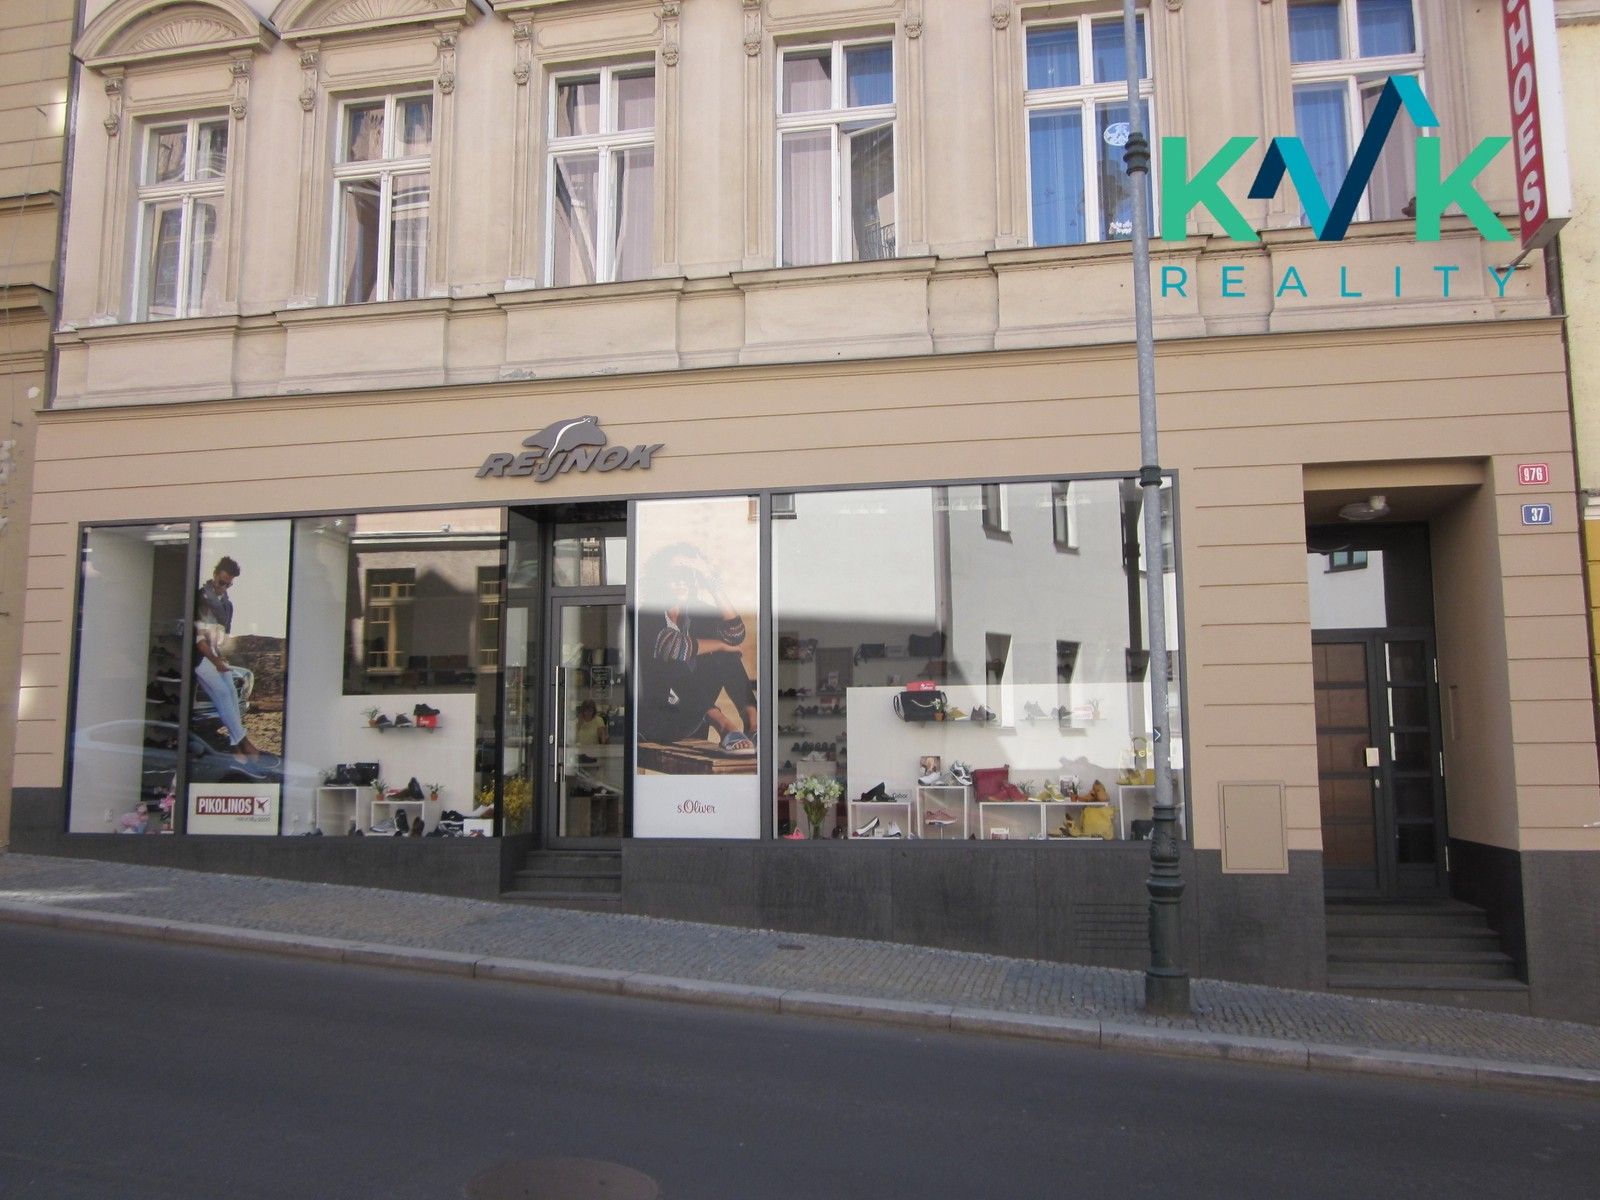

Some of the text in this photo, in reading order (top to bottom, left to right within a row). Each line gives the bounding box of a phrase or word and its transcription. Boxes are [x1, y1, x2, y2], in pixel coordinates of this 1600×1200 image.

[1506, 0, 1541, 222] HOES
[1523, 467, 1543, 481] 976
[1531, 507, 1543, 521] 37
[198, 798, 252, 814] PIKOLINOS
[677, 799, 716, 814] s.Oliver
